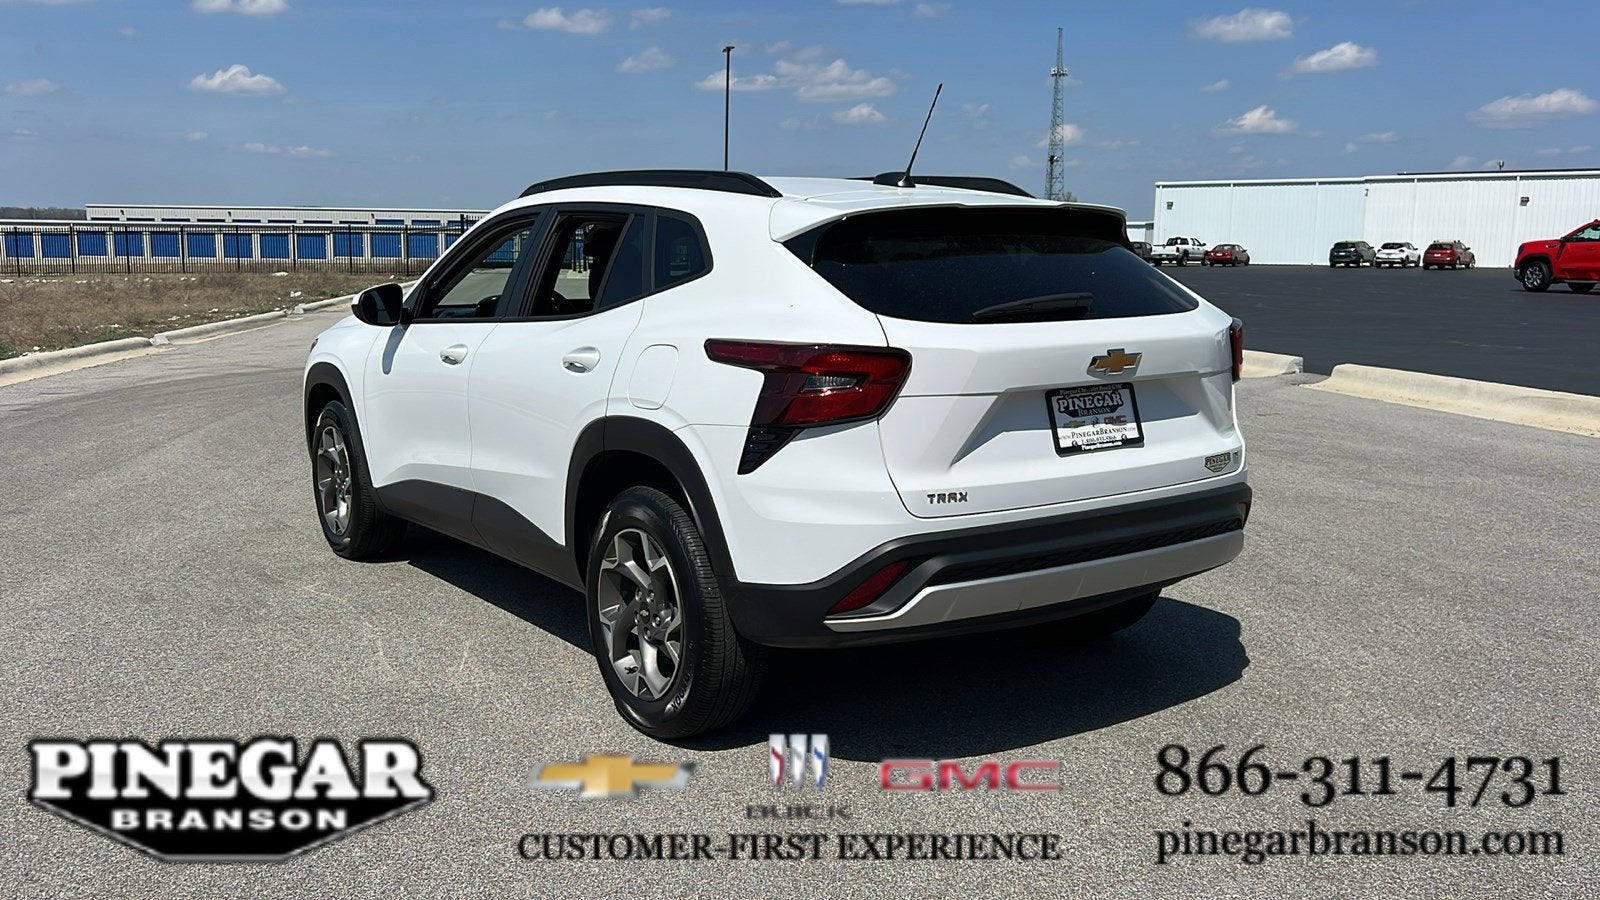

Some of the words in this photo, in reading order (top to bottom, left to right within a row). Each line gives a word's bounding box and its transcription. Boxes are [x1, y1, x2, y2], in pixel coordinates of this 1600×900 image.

[1058, 393, 1123, 411] PINEGAR
[1078, 406, 1111, 417] BRANSON
[1103, 415, 1127, 426] GMC
[927, 491, 968, 504] TRAX
